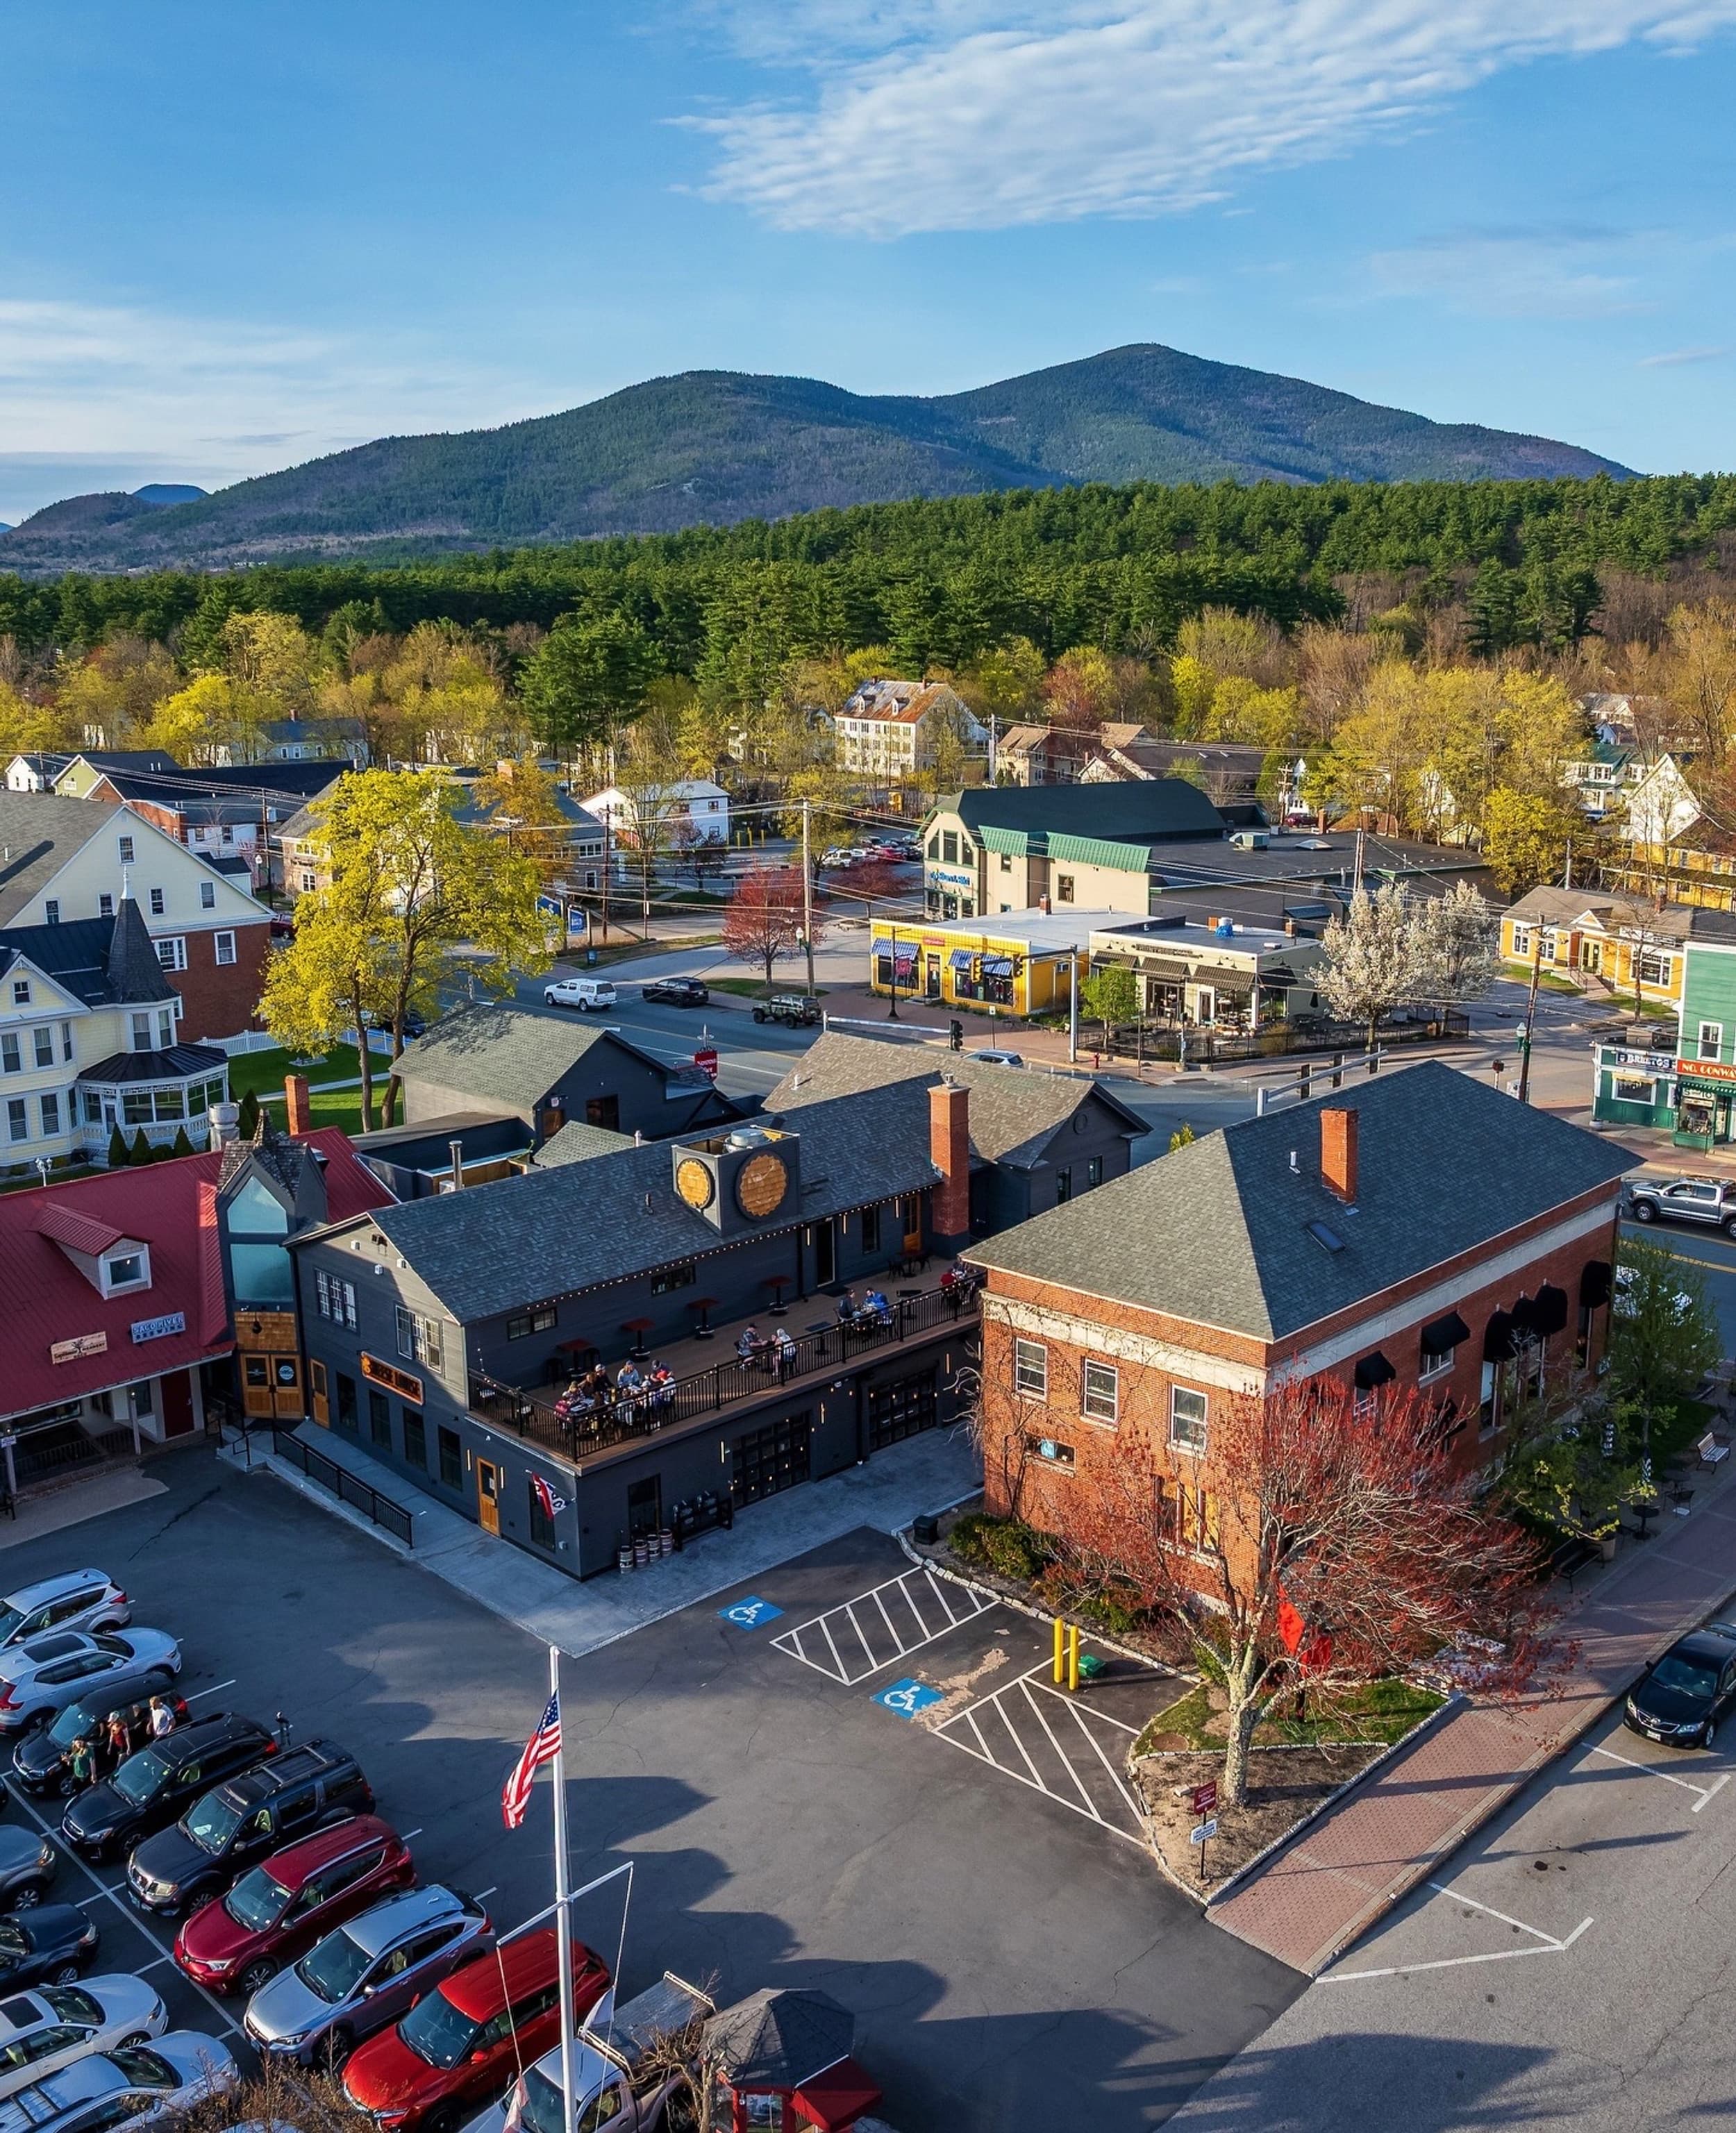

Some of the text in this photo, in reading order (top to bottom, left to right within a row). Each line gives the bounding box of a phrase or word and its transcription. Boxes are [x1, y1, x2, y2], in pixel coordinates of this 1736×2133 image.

[1682, 1063, 1736, 1078] NO. CONWA
[133, 1315, 184, 1333] SACO RIVER
